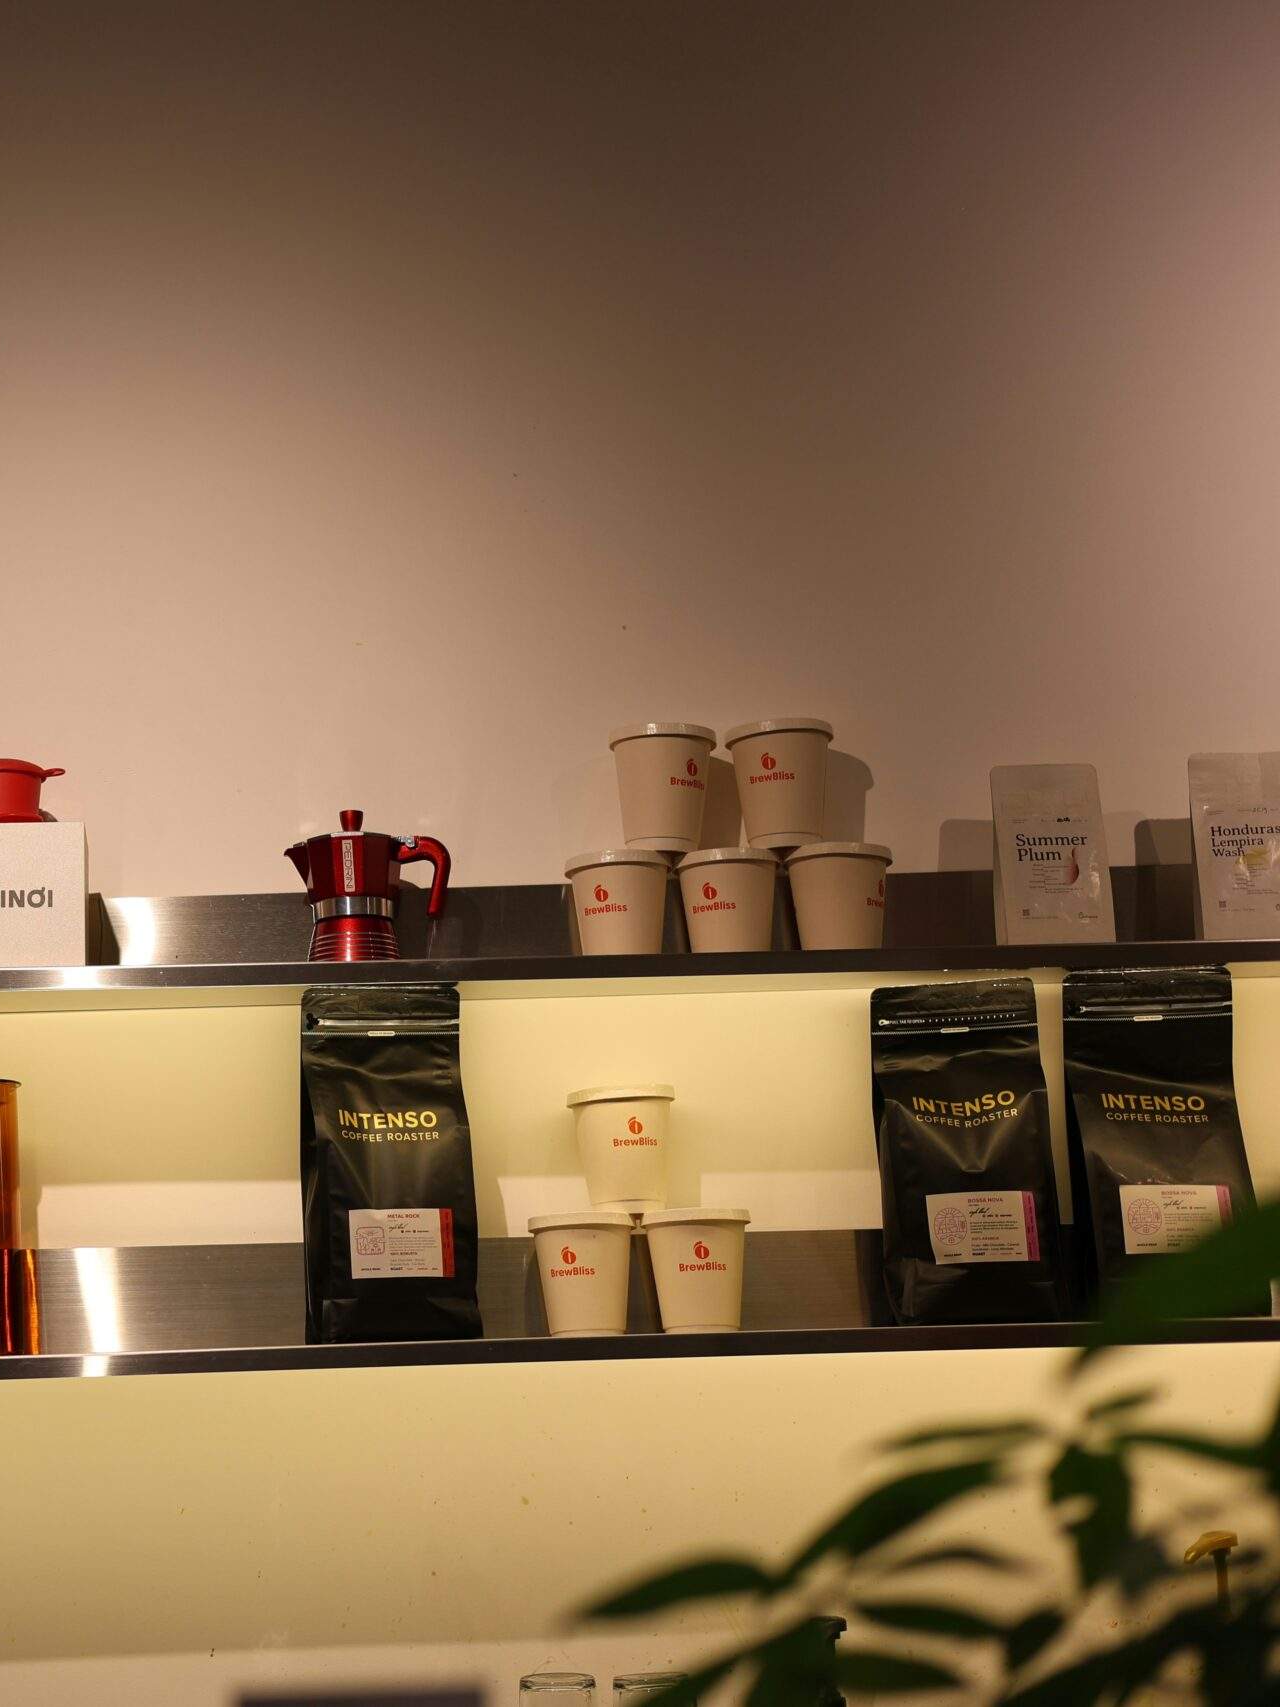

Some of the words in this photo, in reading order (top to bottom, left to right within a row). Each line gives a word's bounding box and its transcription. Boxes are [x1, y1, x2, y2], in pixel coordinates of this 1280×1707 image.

[749, 771, 796, 785] BrewBliss
[1210, 824, 1280, 837] Honduras
[1015, 833, 1088, 847] Summer
[1211, 837, 1264, 849] Lempira
[1017, 848, 1062, 862] Plum
[1212, 848, 1246, 857] Wash
[584, 902, 628, 917] BrewBliss
[692, 900, 737, 915] BrewBliss
[912, 1090, 1015, 1117] INTENSO
[1101, 1093, 1205, 1111] INTENSO
[339, 1109, 437, 1129] INTENSO
[916, 1114, 960, 1127] COFFEE
[965, 1108, 1018, 1128] ROASTER
[1106, 1112, 1151, 1122] COFFEE
[1155, 1114, 1209, 1123] ROASTER
[342, 1130, 382, 1142] COFFEE
[387, 1131, 440, 1141] ROASTER
[613, 1136, 658, 1147] BrewBliss
[550, 1265, 596, 1278] BrewBliss
[678, 1261, 727, 1272] BrewBliss
